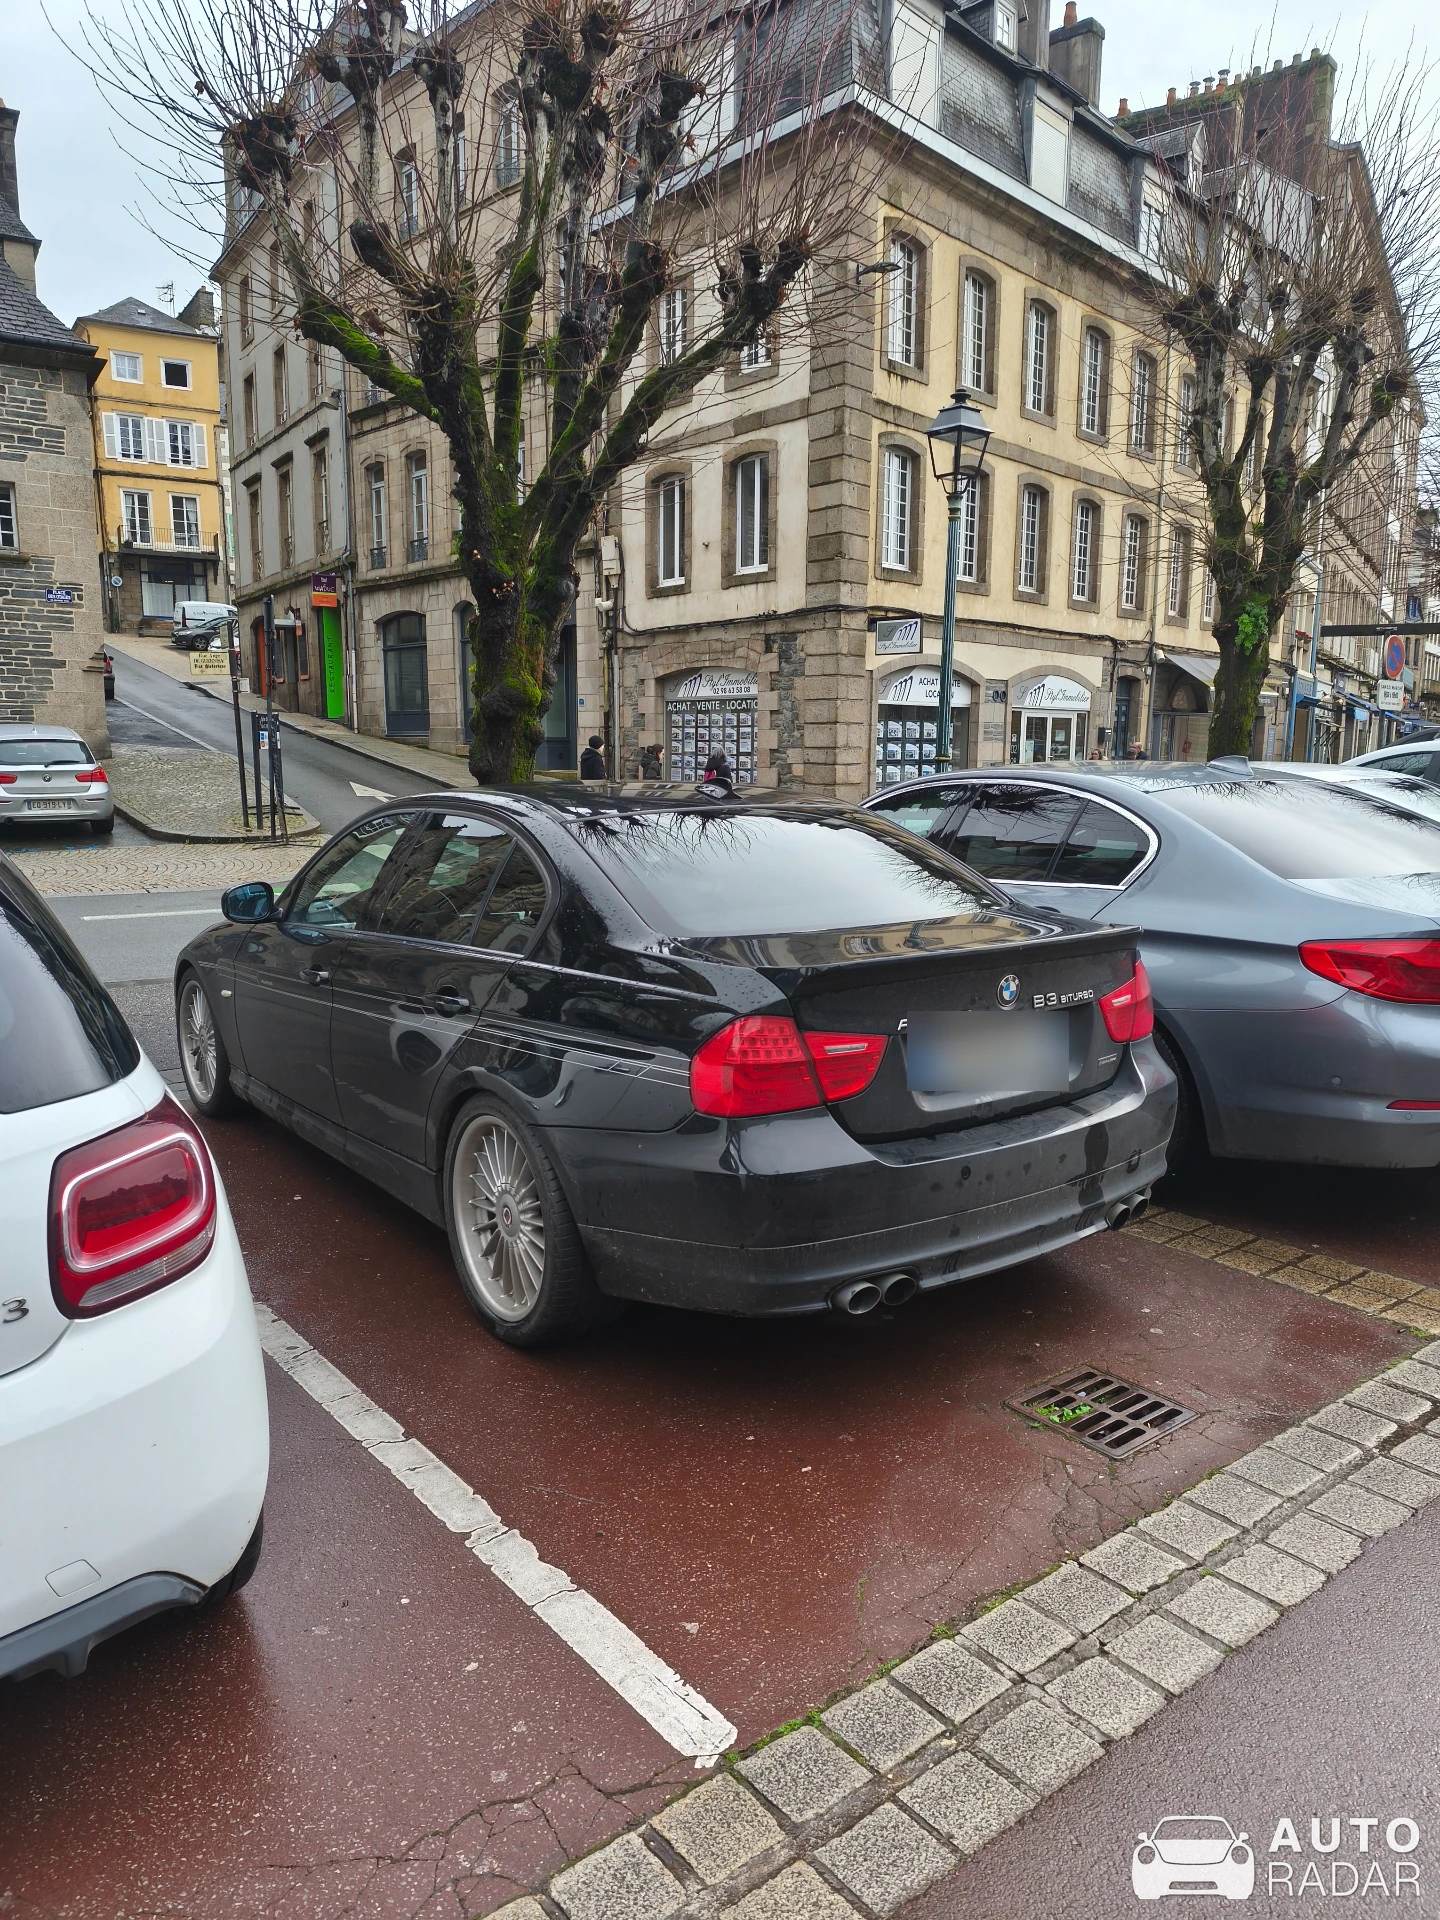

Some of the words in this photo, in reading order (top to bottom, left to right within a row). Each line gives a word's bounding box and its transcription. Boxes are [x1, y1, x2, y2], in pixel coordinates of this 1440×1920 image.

[326, 635, 336, 694] RESTAURANT
[918, 677, 939, 686] ACHAT
[667, 701, 691, 711] ACHAT
[696, 700, 720, 711] VENTE
[1033, 992, 1057, 1008] B3
[1060, 989, 1094, 1004] BITURBO
[2, 1296, 29, 1323] 3
